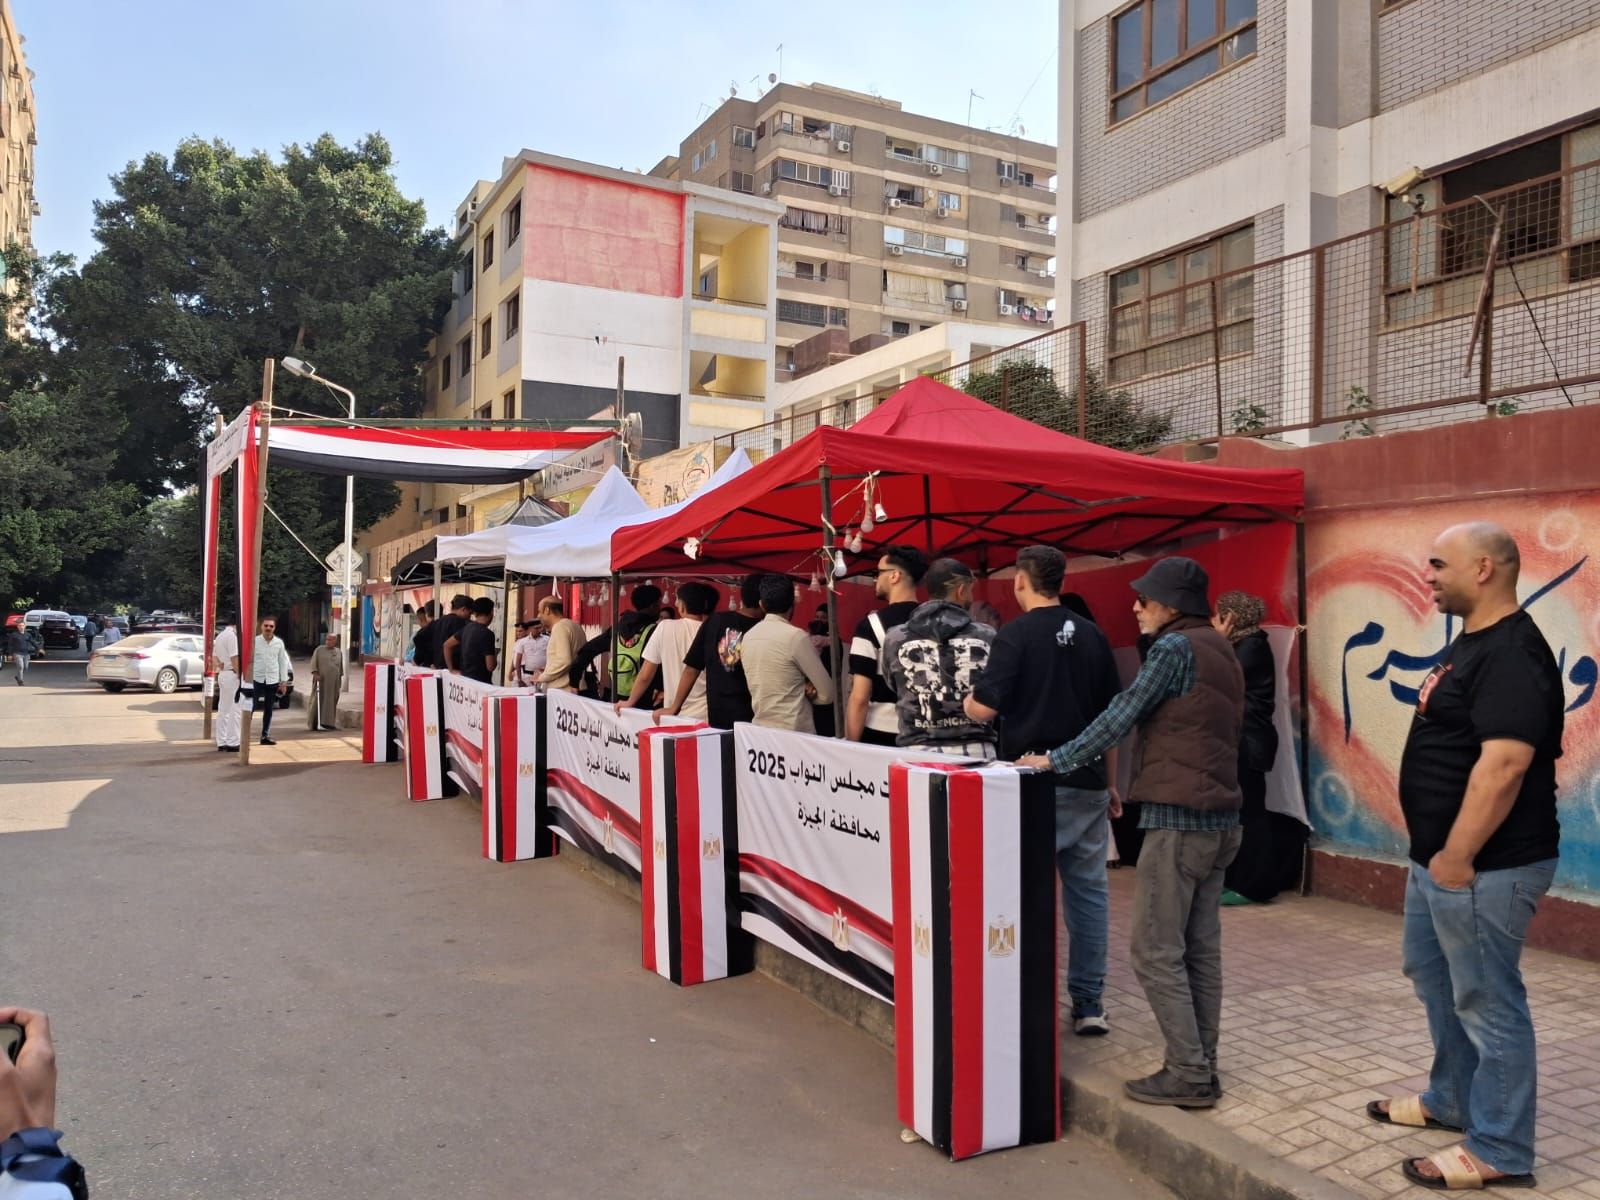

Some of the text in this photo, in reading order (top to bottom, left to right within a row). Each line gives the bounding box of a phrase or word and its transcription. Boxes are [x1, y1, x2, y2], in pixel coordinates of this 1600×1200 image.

[449, 681, 464, 704] 2025
[556, 706, 579, 736] 2025
[581, 716, 602, 741] النواب
[604, 724, 630, 752] مجلس
[586, 751, 630, 783] محافظة الجيزة
[748, 749, 786, 780] 2025
[789, 760, 826, 786] النواب
[830, 768, 875, 799] مجلس
[798, 801, 880, 843] محافظة الجيزة
